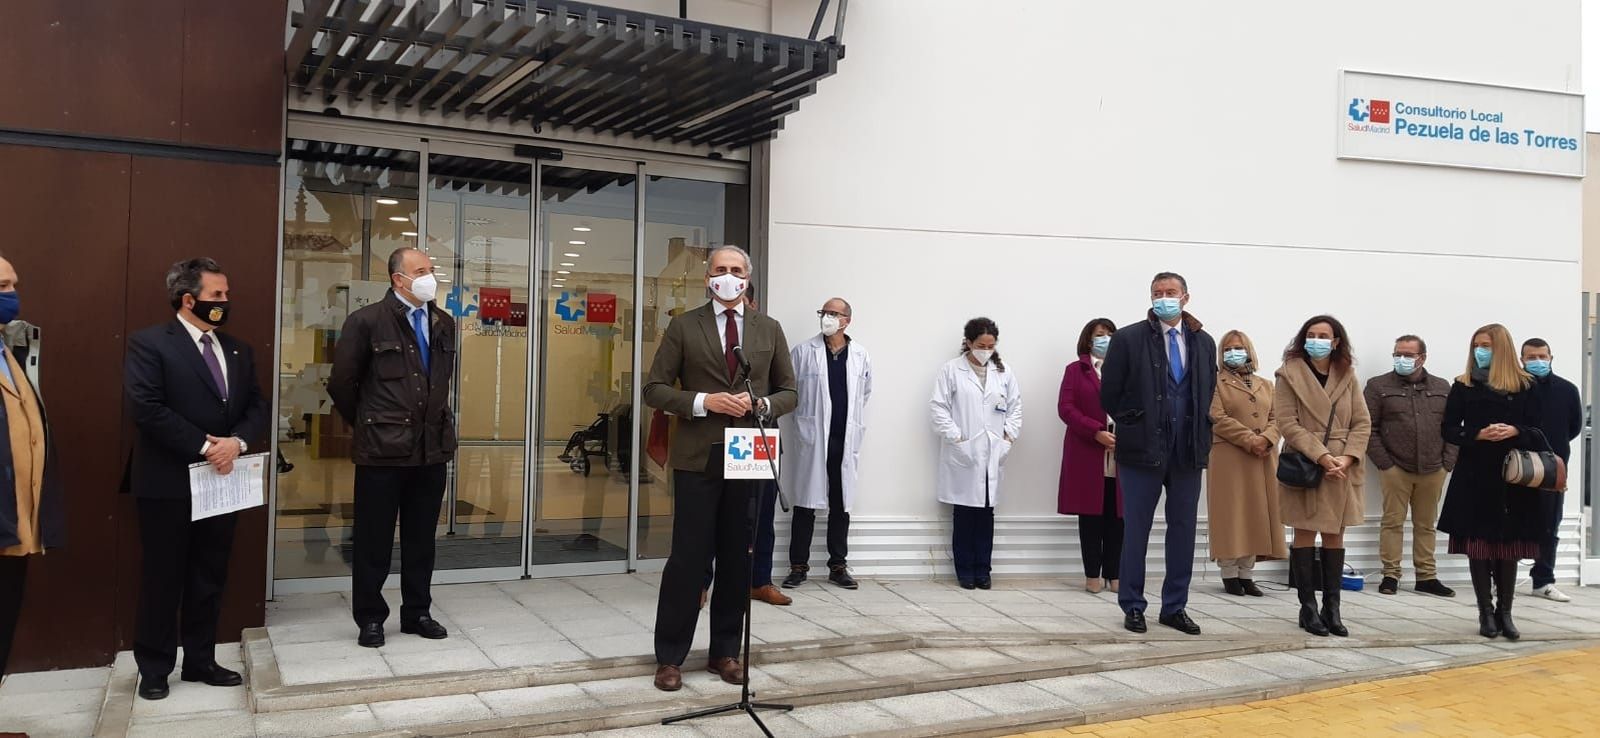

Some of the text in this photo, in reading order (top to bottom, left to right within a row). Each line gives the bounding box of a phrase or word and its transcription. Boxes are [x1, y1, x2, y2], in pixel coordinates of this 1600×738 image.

[1395, 102, 1503, 123] Consultorio Local
[1348, 122, 1391, 134] SaludMadrid
[1395, 118, 1578, 151] Pezuela de las Torres
